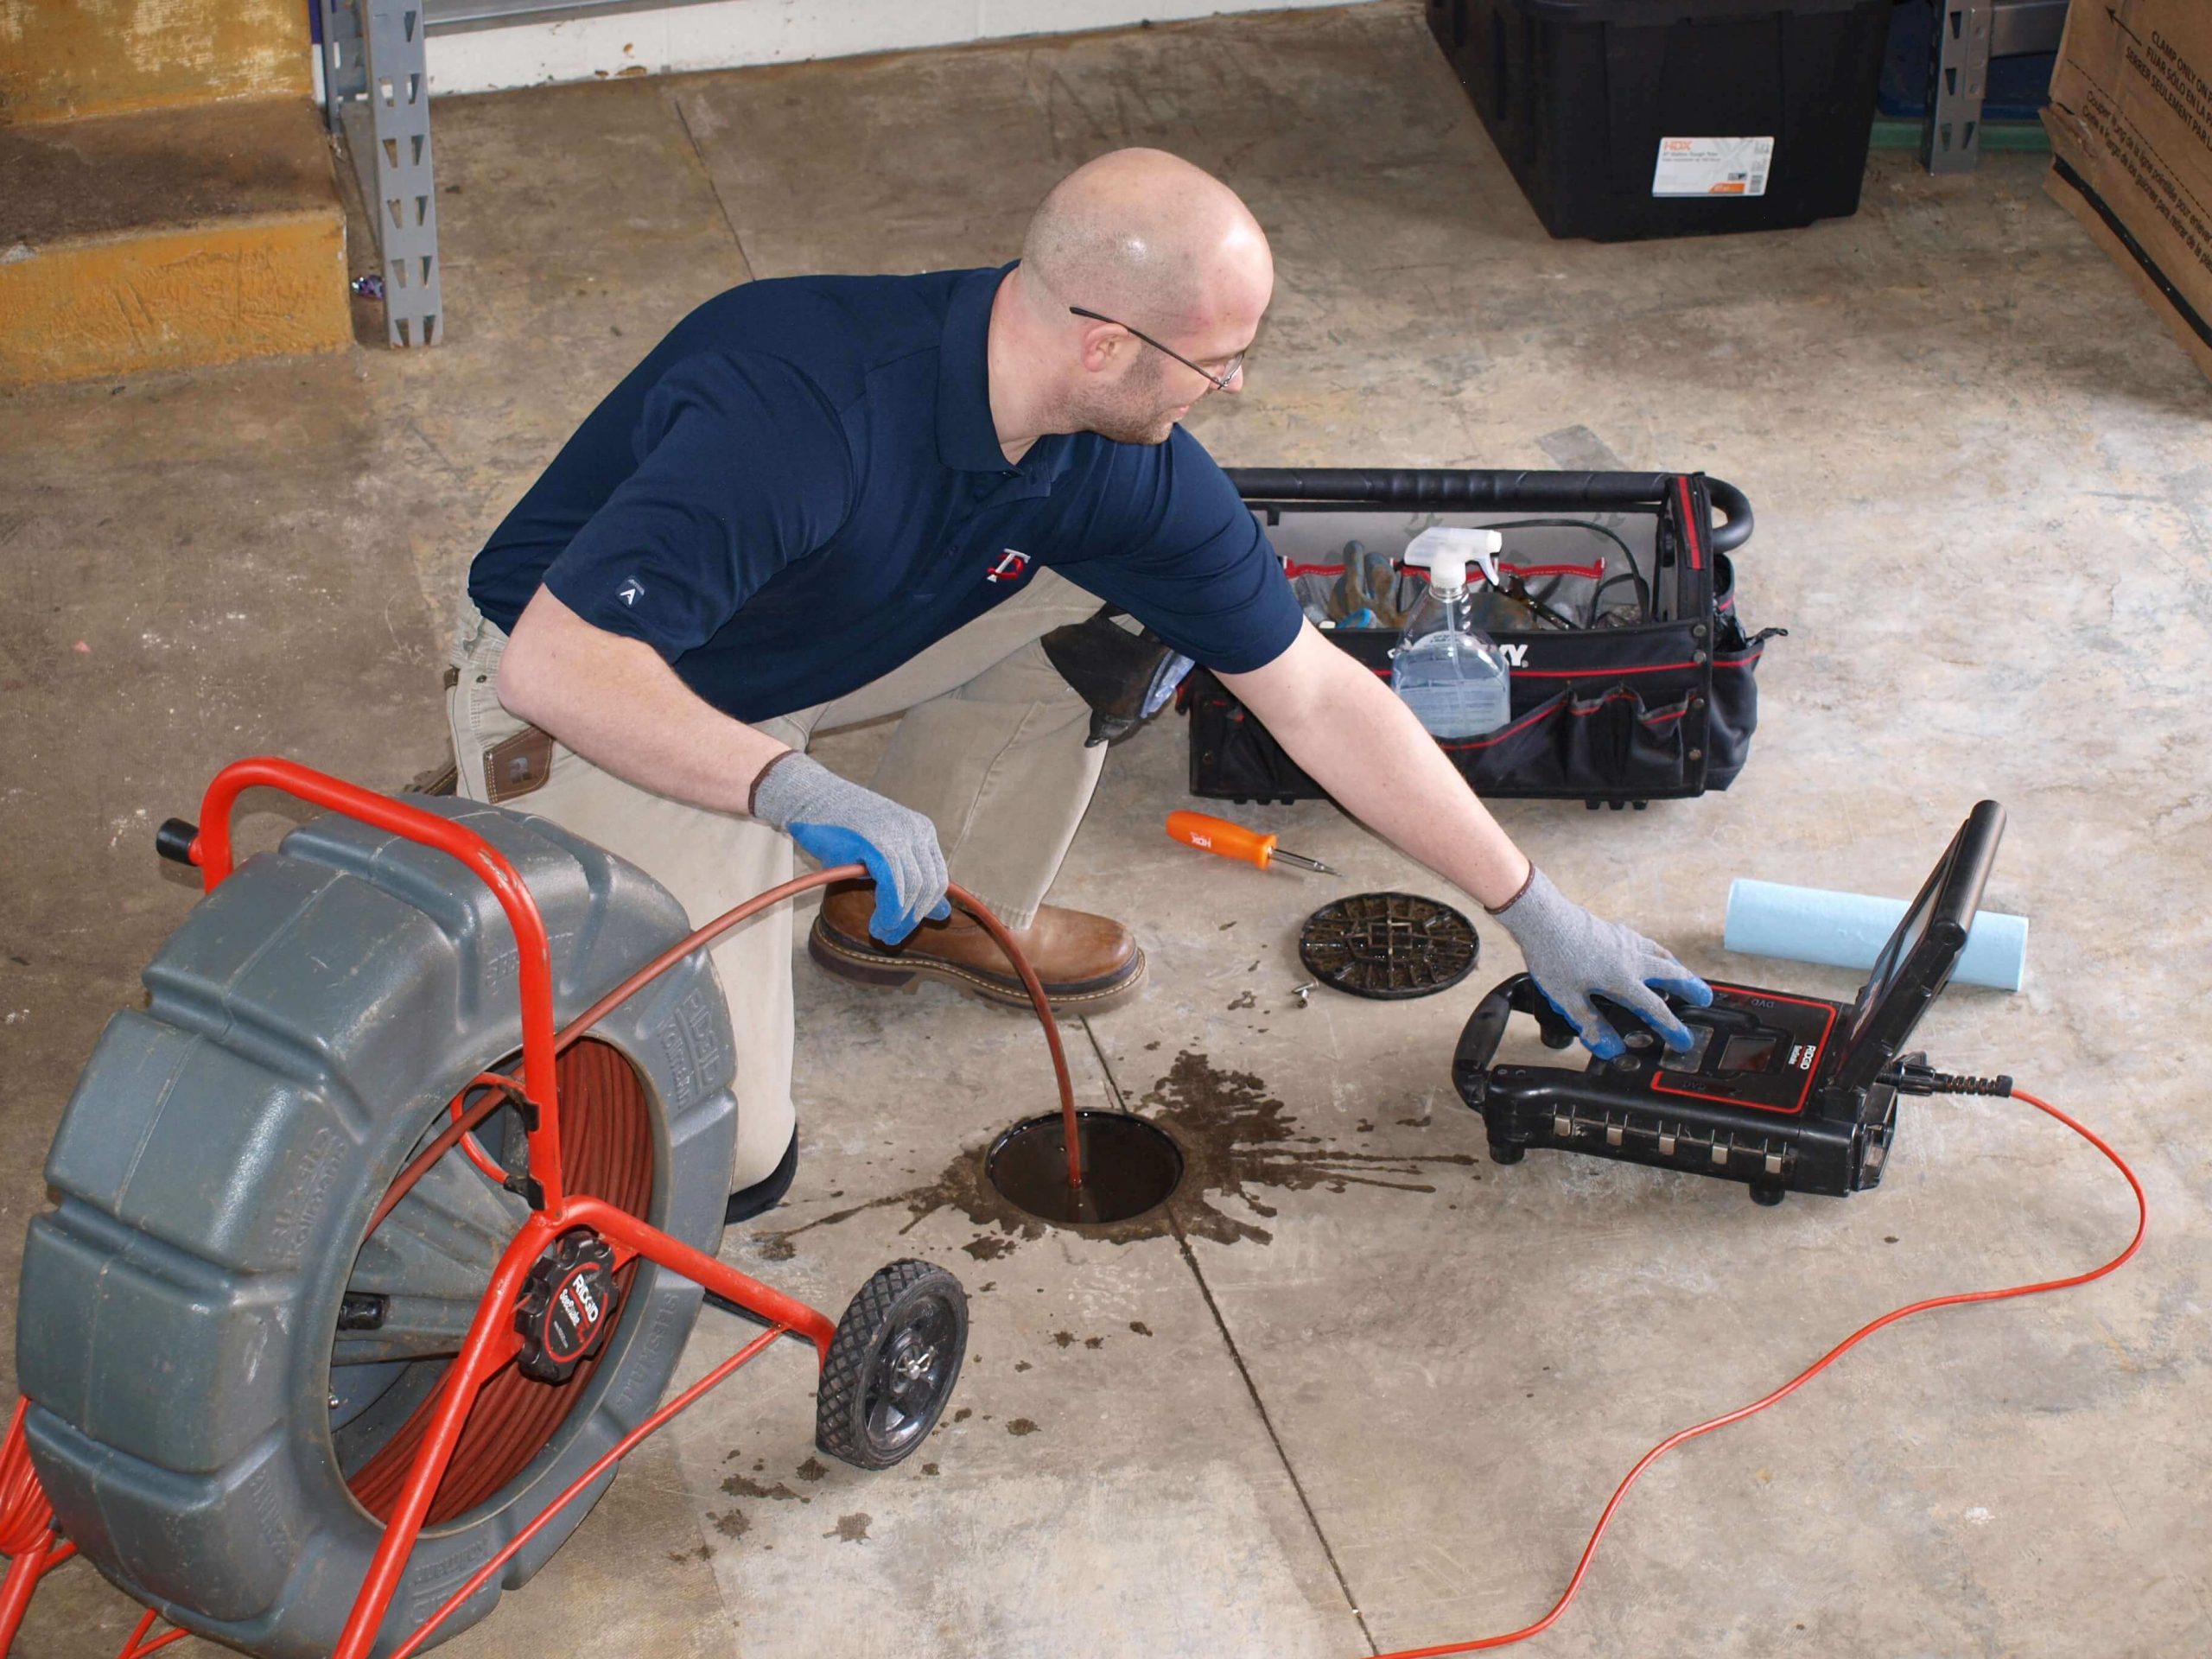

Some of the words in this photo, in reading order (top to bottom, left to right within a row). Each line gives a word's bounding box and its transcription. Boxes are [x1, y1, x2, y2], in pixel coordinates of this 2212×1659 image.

[2152, 30, 2177, 62] CLAMP
[2177, 57, 2196, 85] ONLY
[2196, 79, 2208, 99] ON
[2151, 74, 2192, 127] SEULEMENT
[2192, 119, 2207, 144] PAR
[2185, 89, 2196, 108] EN
[2196, 99, 2205, 119] LA
[1662, 140, 1693, 151] HDX
[572, 1273, 599, 1324] RIDGID
